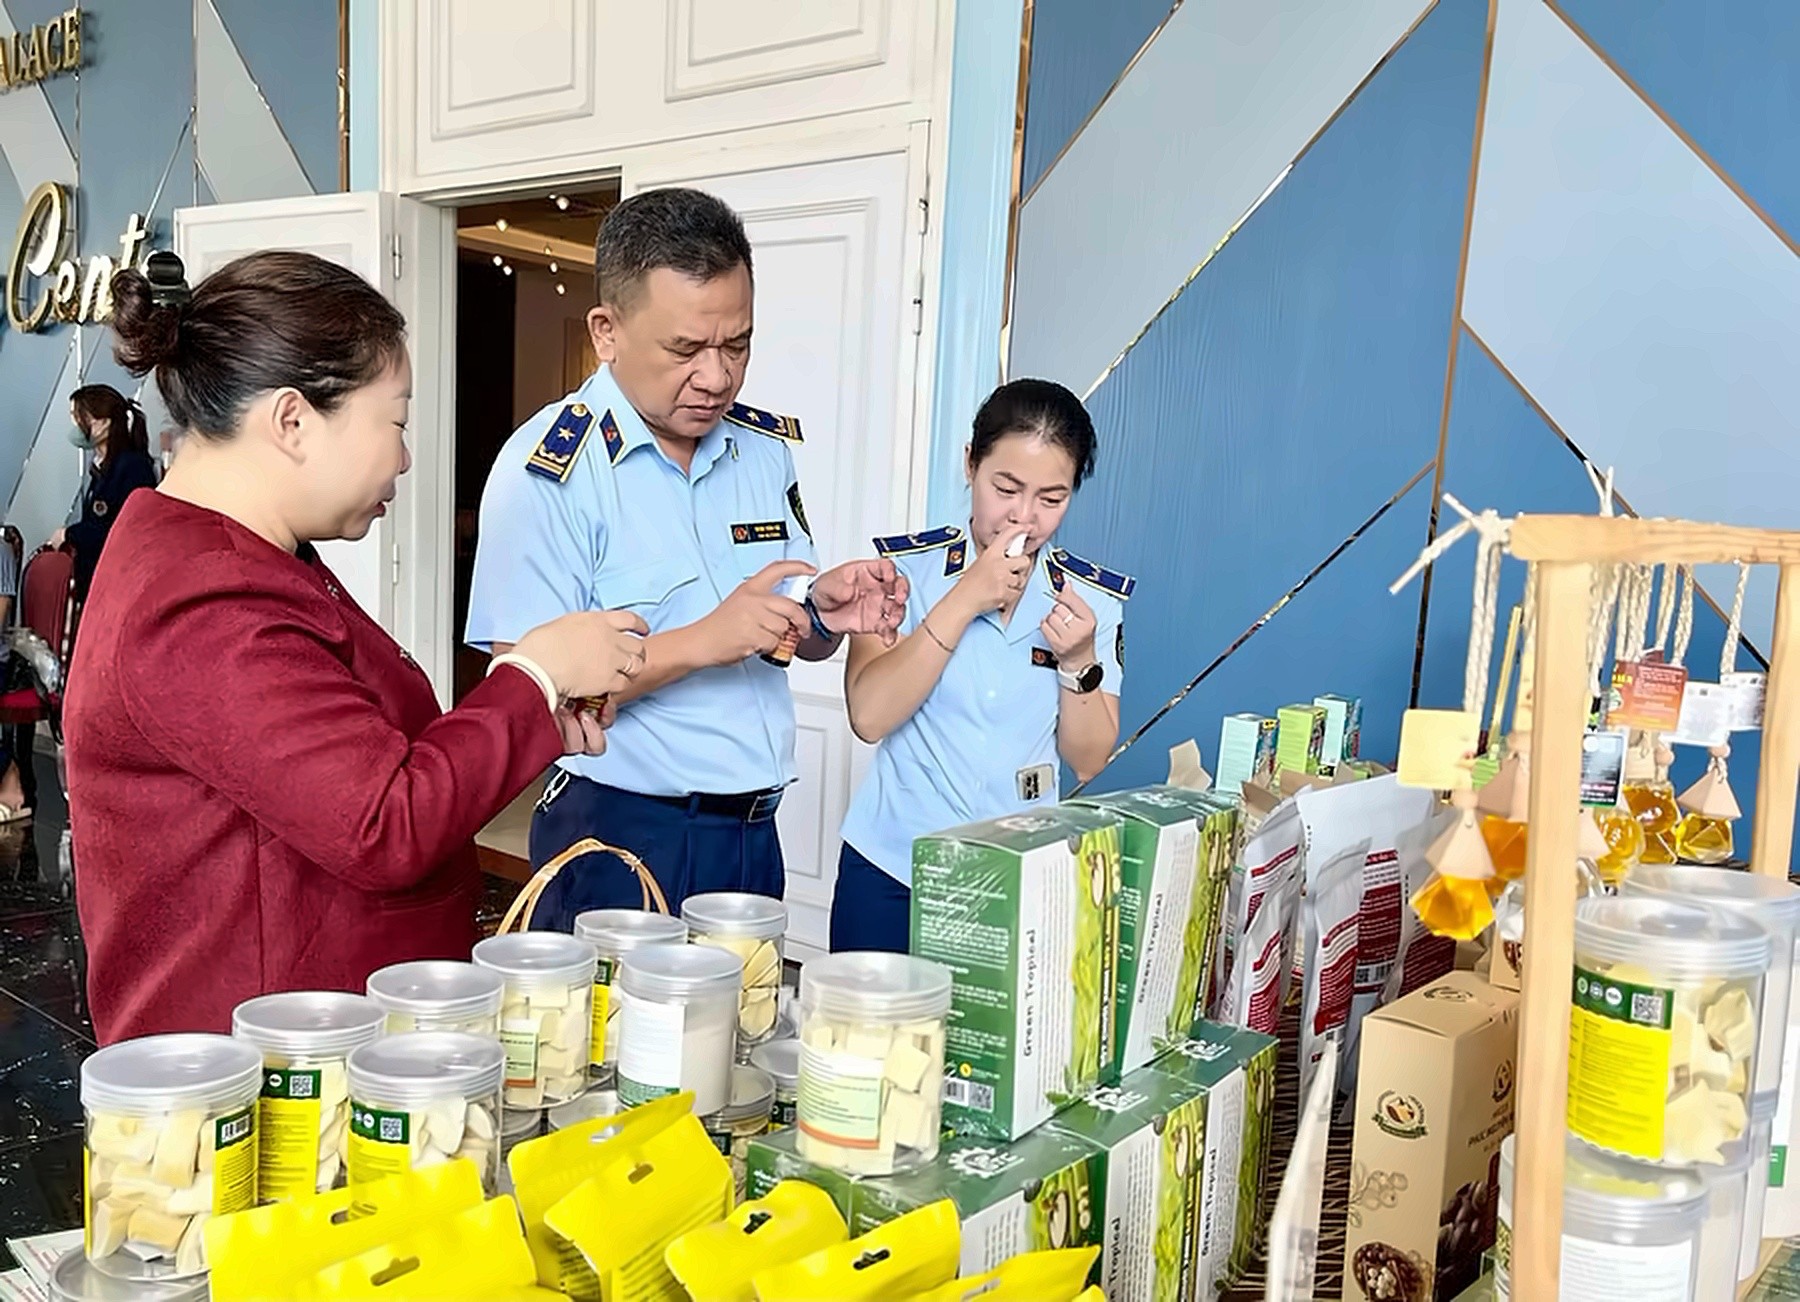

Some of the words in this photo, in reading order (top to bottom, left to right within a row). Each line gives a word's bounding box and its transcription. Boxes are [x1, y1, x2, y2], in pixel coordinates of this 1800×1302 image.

[1025, 929, 1038, 998] Tropical
[1023, 1005, 1035, 1057] Green
[1205, 1148, 1217, 1207] Tropical
[1107, 1216, 1121, 1287] Tropical
[1201, 1212, 1212, 1257] Green
